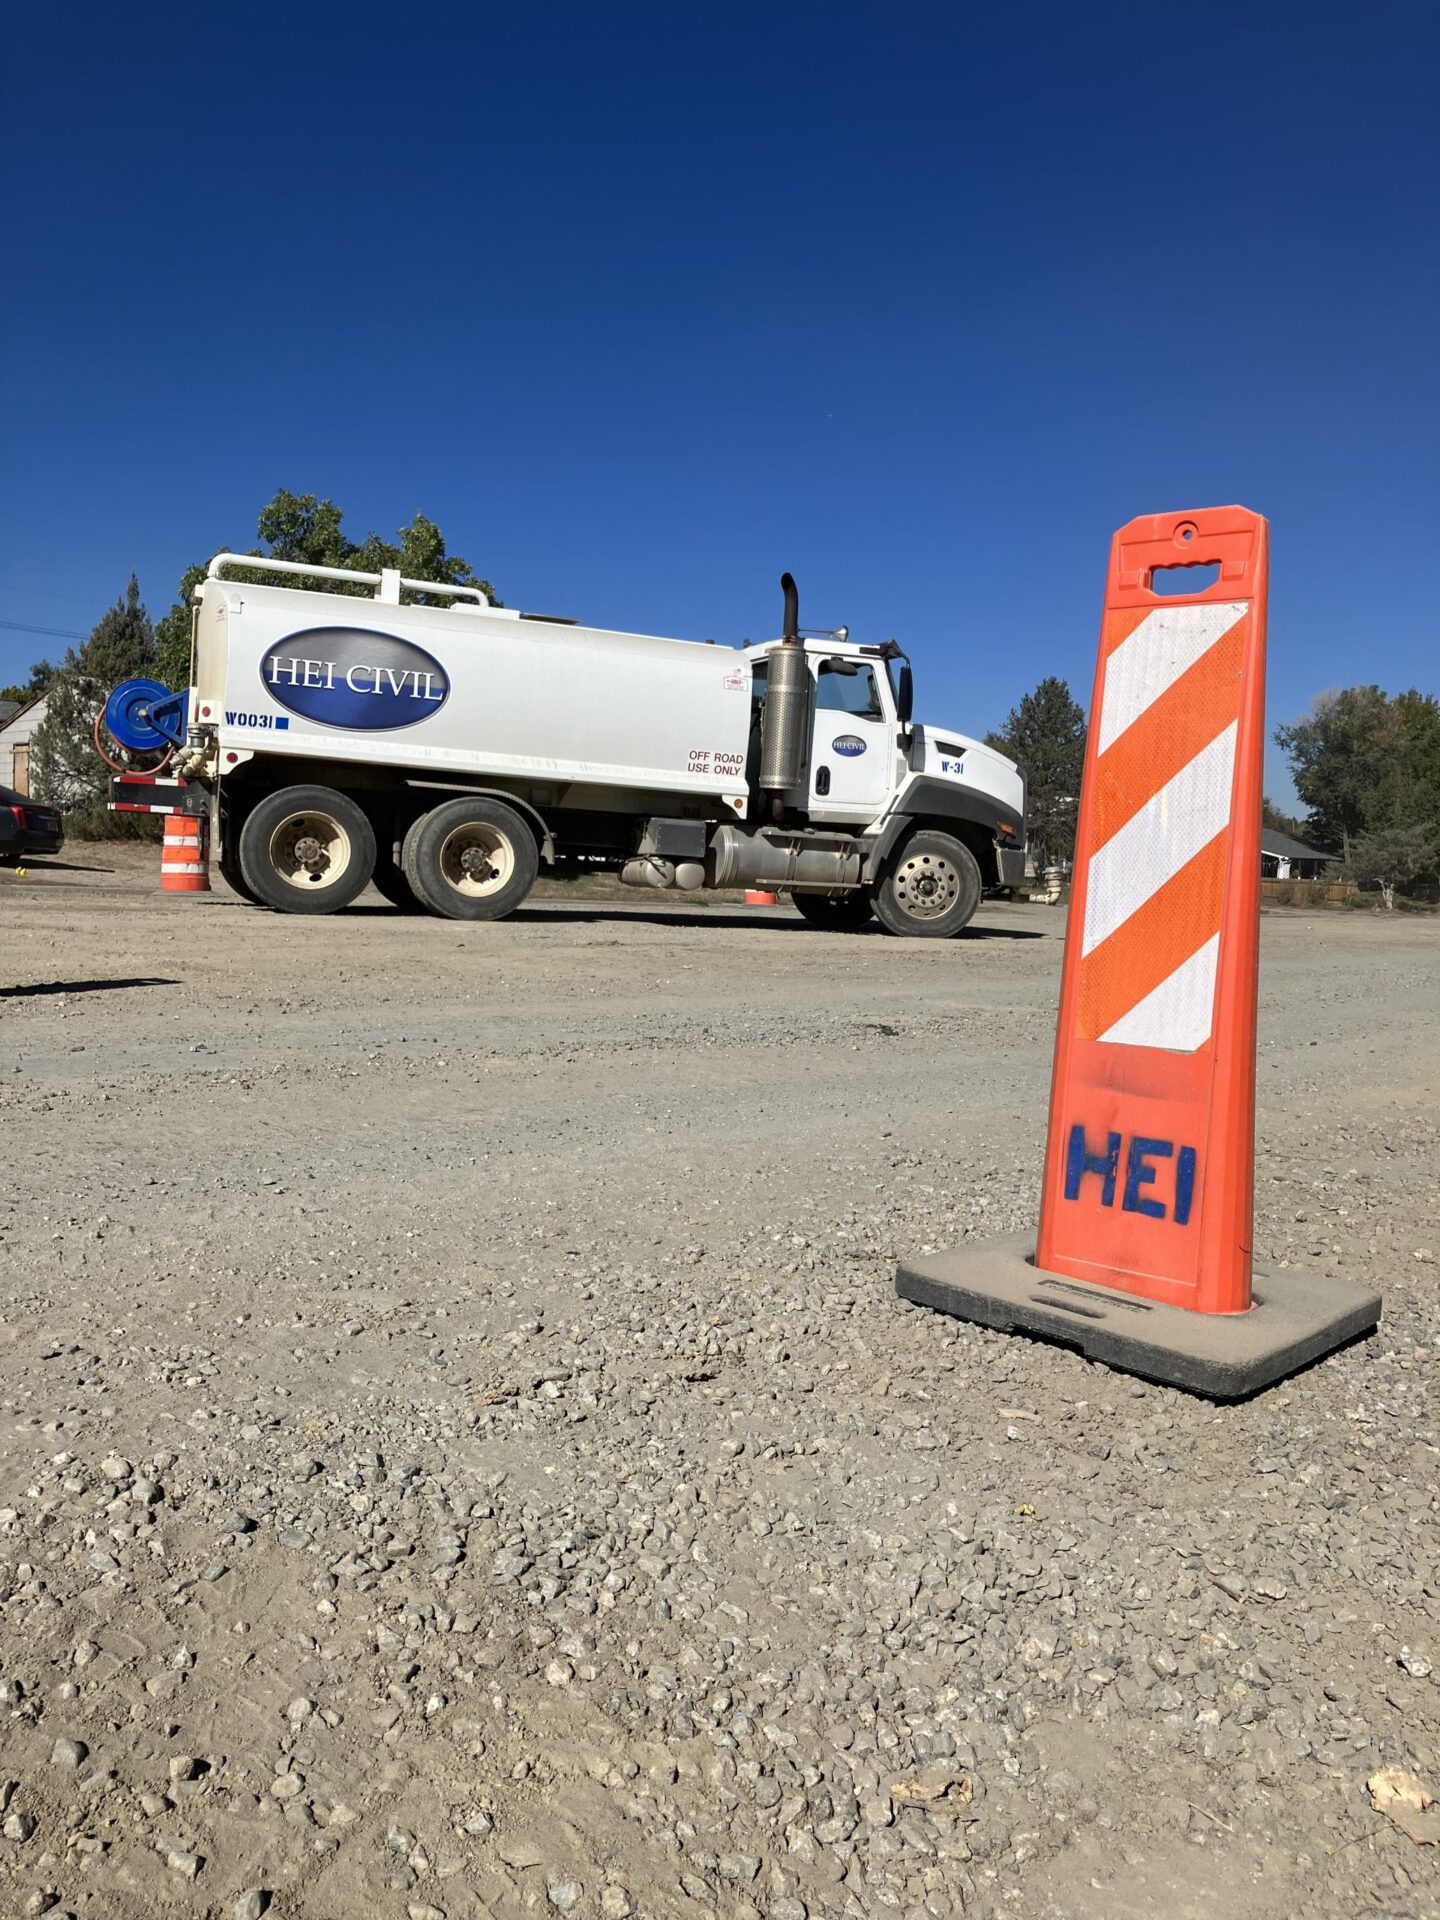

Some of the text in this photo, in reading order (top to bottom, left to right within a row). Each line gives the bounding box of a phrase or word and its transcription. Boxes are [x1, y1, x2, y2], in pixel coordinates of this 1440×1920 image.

[269, 656, 443, 700] HEI CIVIL
[833, 741, 846, 749] HEI
[689, 750, 744, 764] OFF ROAD
[687, 762, 741, 775] USE ONLY
[941, 760, 964, 775] W-31
[1064, 1125, 1196, 1225] HEI
